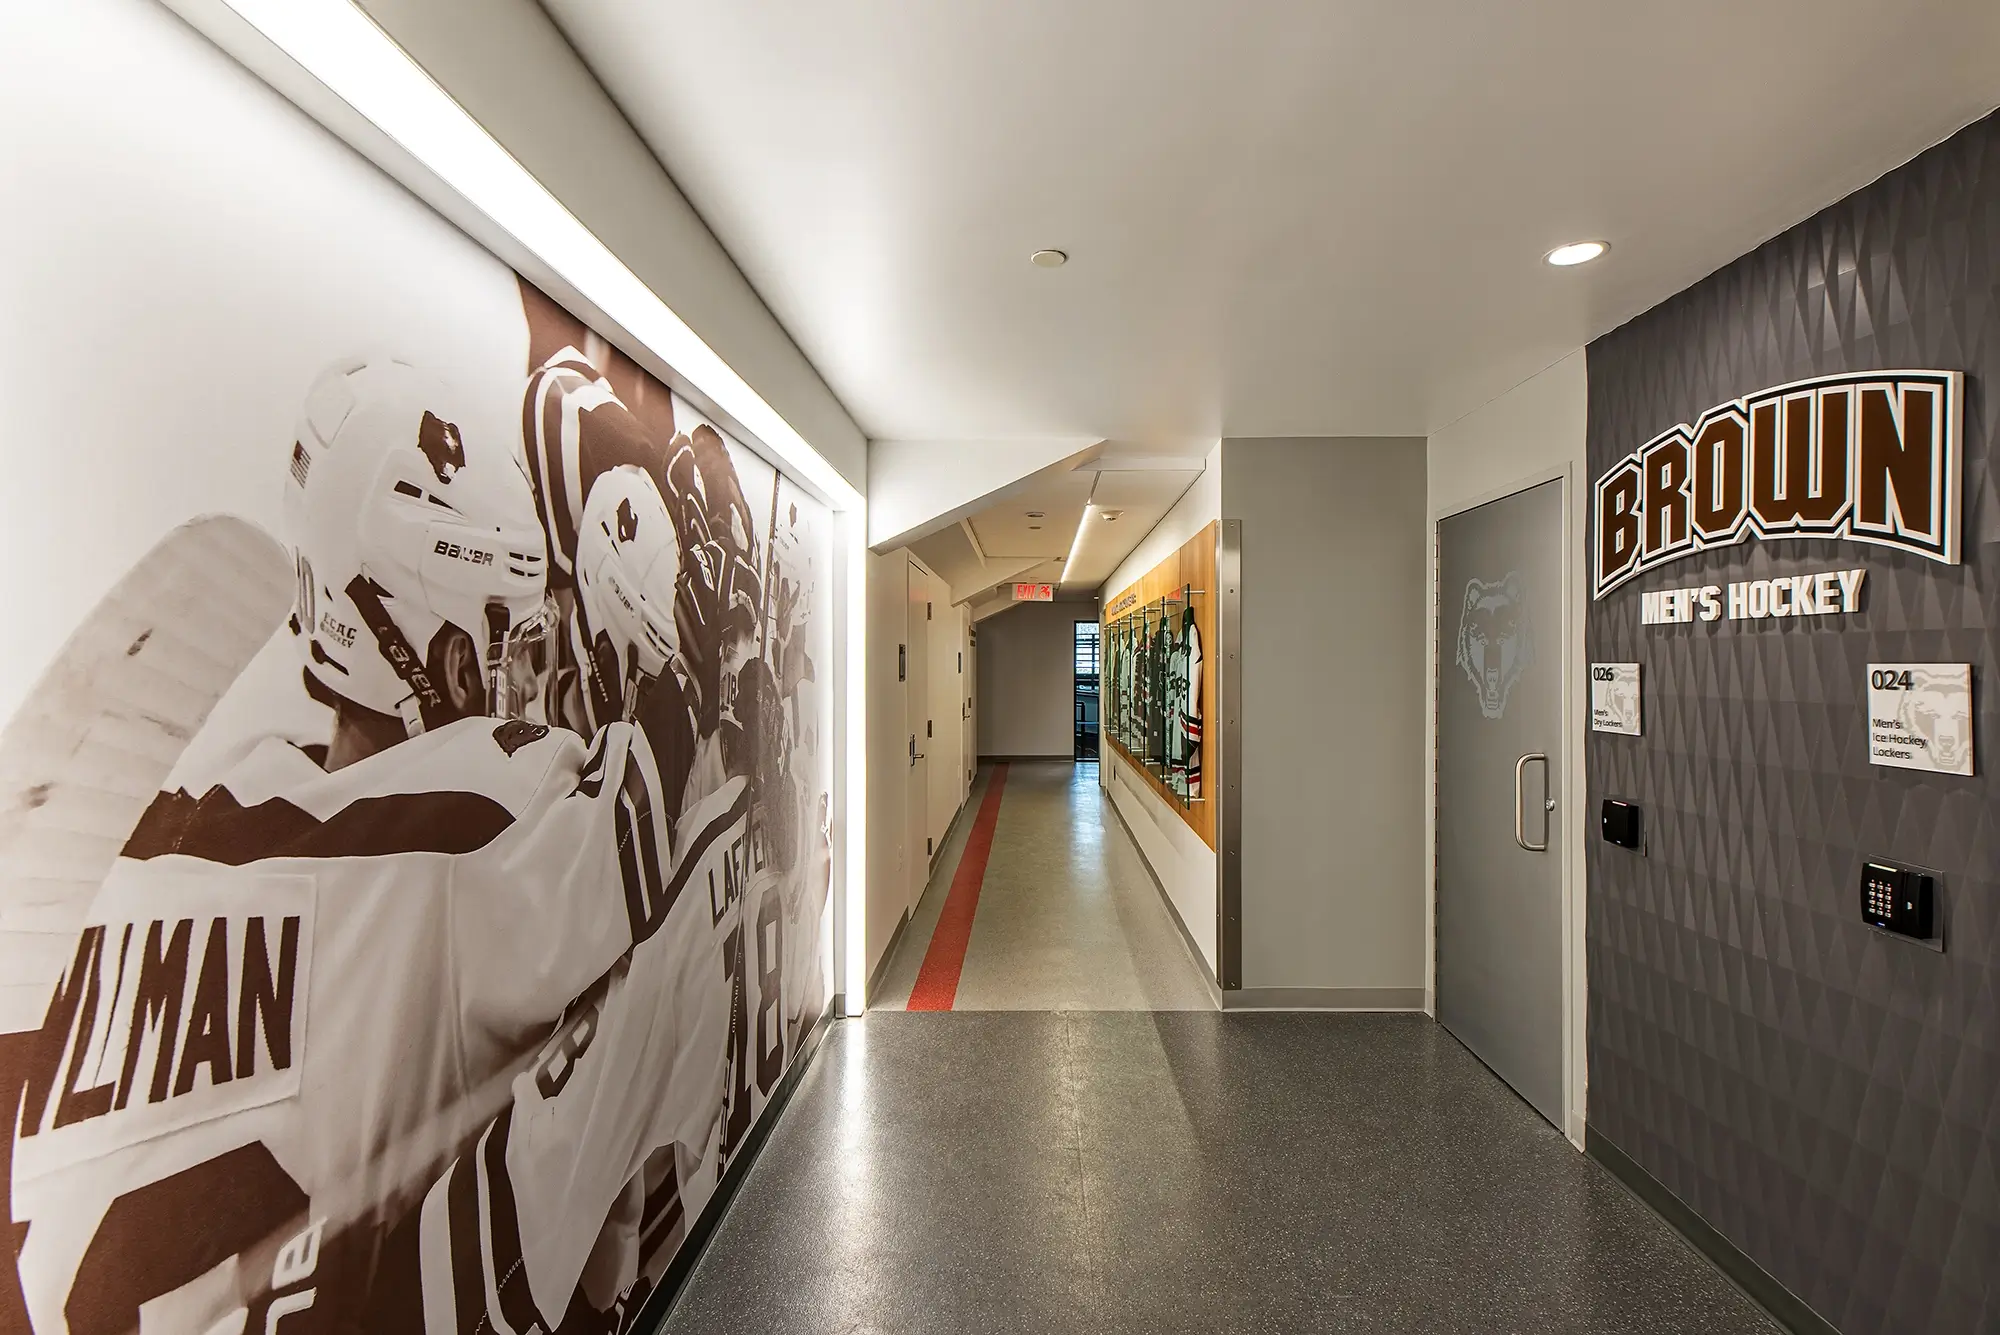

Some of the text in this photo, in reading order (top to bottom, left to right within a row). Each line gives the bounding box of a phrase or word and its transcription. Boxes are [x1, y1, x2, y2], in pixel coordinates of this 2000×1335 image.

[1597, 376, 1950, 592] BROWN
[1016, 584, 1036, 600] EXIT
[1641, 568, 1867, 624] MEN'S HOCKEY
[1593, 667, 1615, 682] 026
[1871, 669, 1914, 691] 024
[1872, 718, 1904, 730] Men's
[1872, 732, 1928, 750] Ice Hockey
[1872, 746, 1912, 760] Lockers
